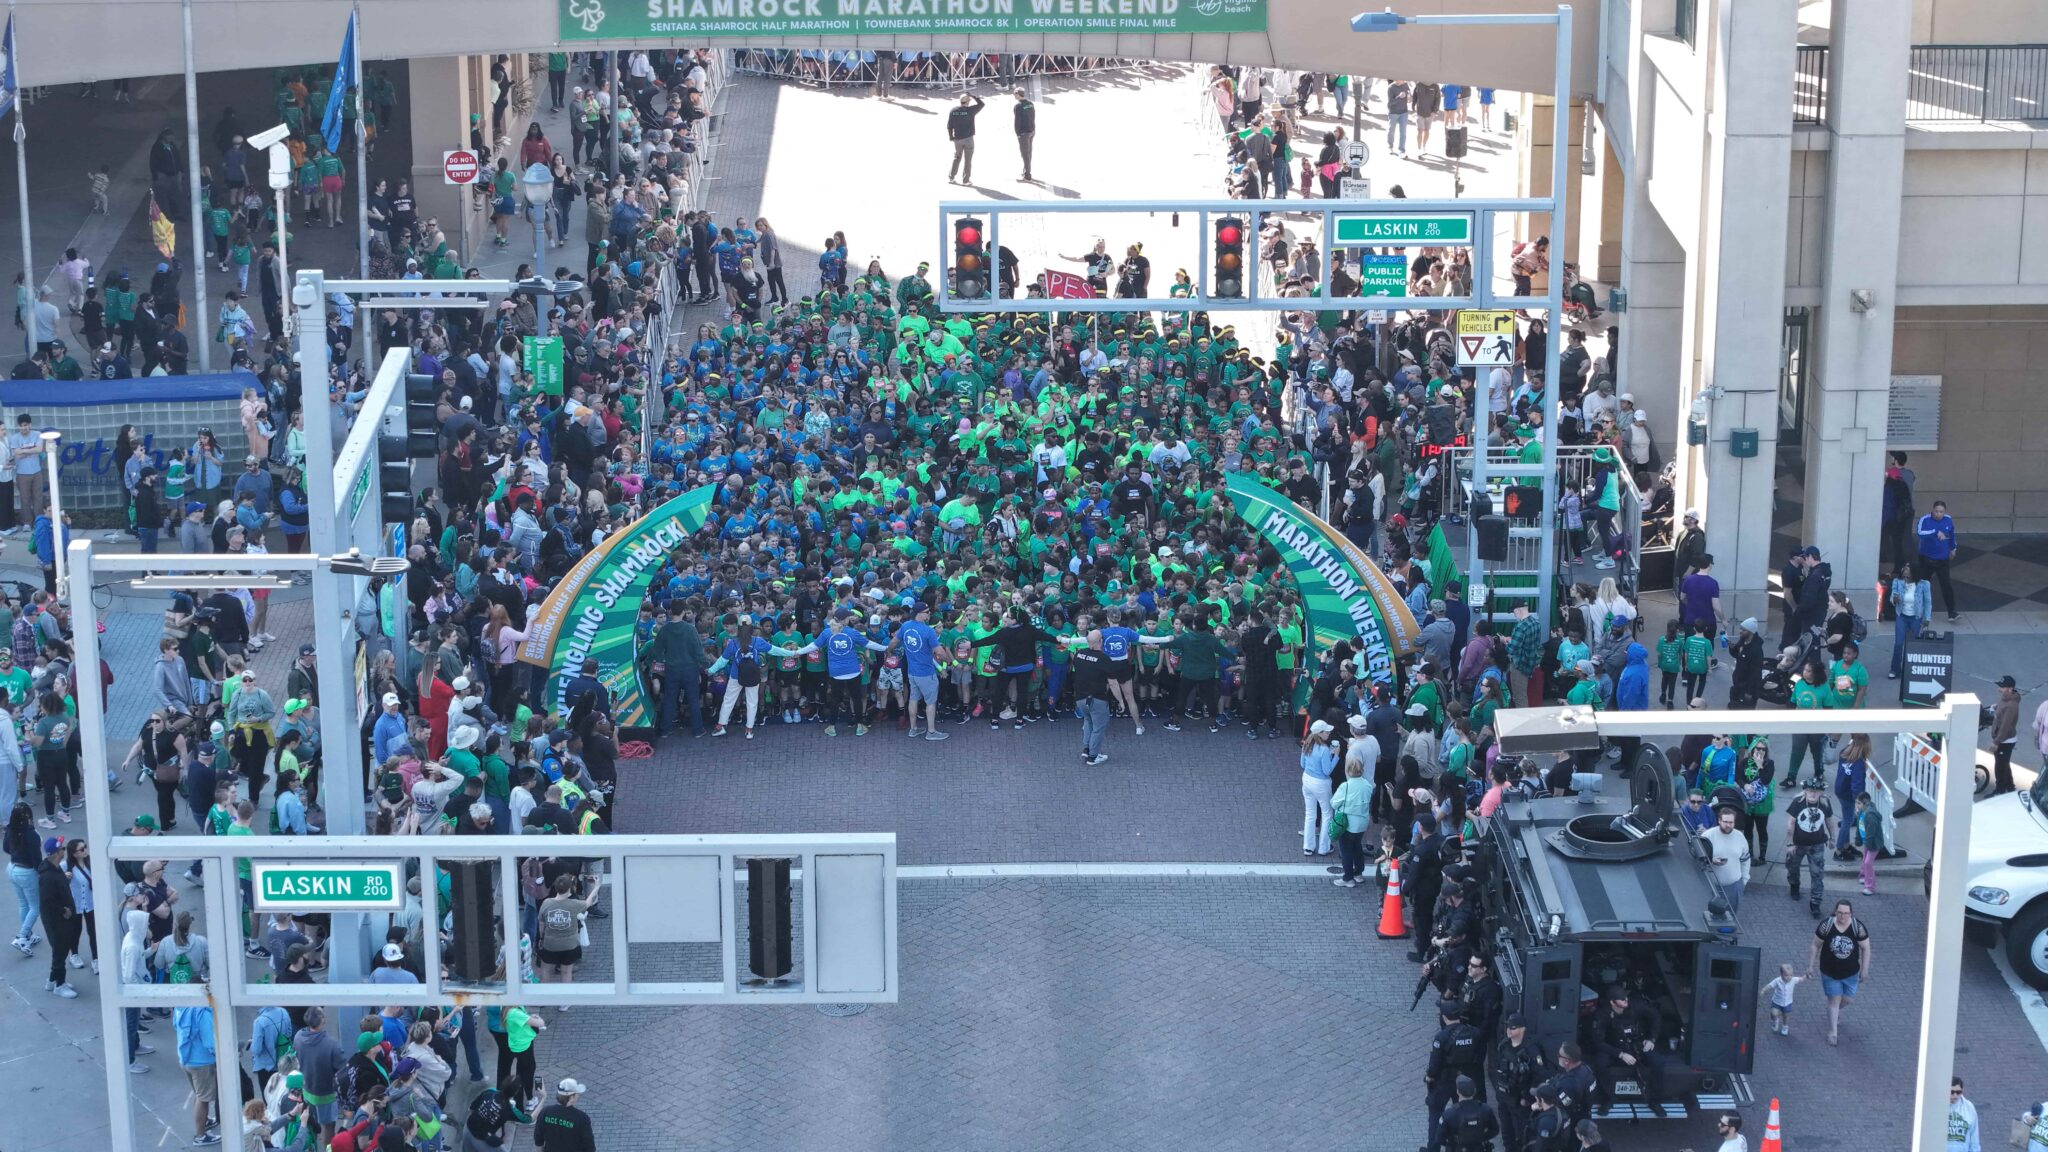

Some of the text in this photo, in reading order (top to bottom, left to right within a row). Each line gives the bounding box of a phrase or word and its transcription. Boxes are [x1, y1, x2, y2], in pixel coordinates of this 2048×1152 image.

[647, 0, 1178, 18] SHAMROCK MARATHON WEEKEND
[1224, 4, 1251, 13] beach
[650, 20, 850, 31] SENTARA SHAMROCK HALF MARATHON
[864, 18, 1009, 29] TOWNEBANK SHAMROCK 8K
[1024, 18, 1176, 27] OPERATION SMILE FINAL MILE
[1364, 222, 1438, 236] LASKIN RD
[1368, 267, 1402, 275] PUBLIC
[1363, 277, 1406, 286] PARKING
[1463, 313, 1491, 322] TURNING
[1461, 324, 1492, 332] VEHICLES
[1482, 347, 1492, 355] TO
[595, 521, 686, 608] SHAMROCK
[1342, 543, 1381, 595] TOWNEBANK
[1378, 592, 1406, 637] SHAMROCK
[1263, 511, 1393, 686] MARATHON WEEKEN
[534, 552, 603, 660] SHAMROCK HALF MARATHON
[525, 623, 543, 657] SENTARA
[1907, 653, 1952, 664] VOLUNTEER
[1912, 665, 1946, 676] SHUTTLE
[266, 876, 383, 895] LASKIN RD
[363, 885, 388, 896] 200
[1455, 1038, 1473, 1047] POLICE
